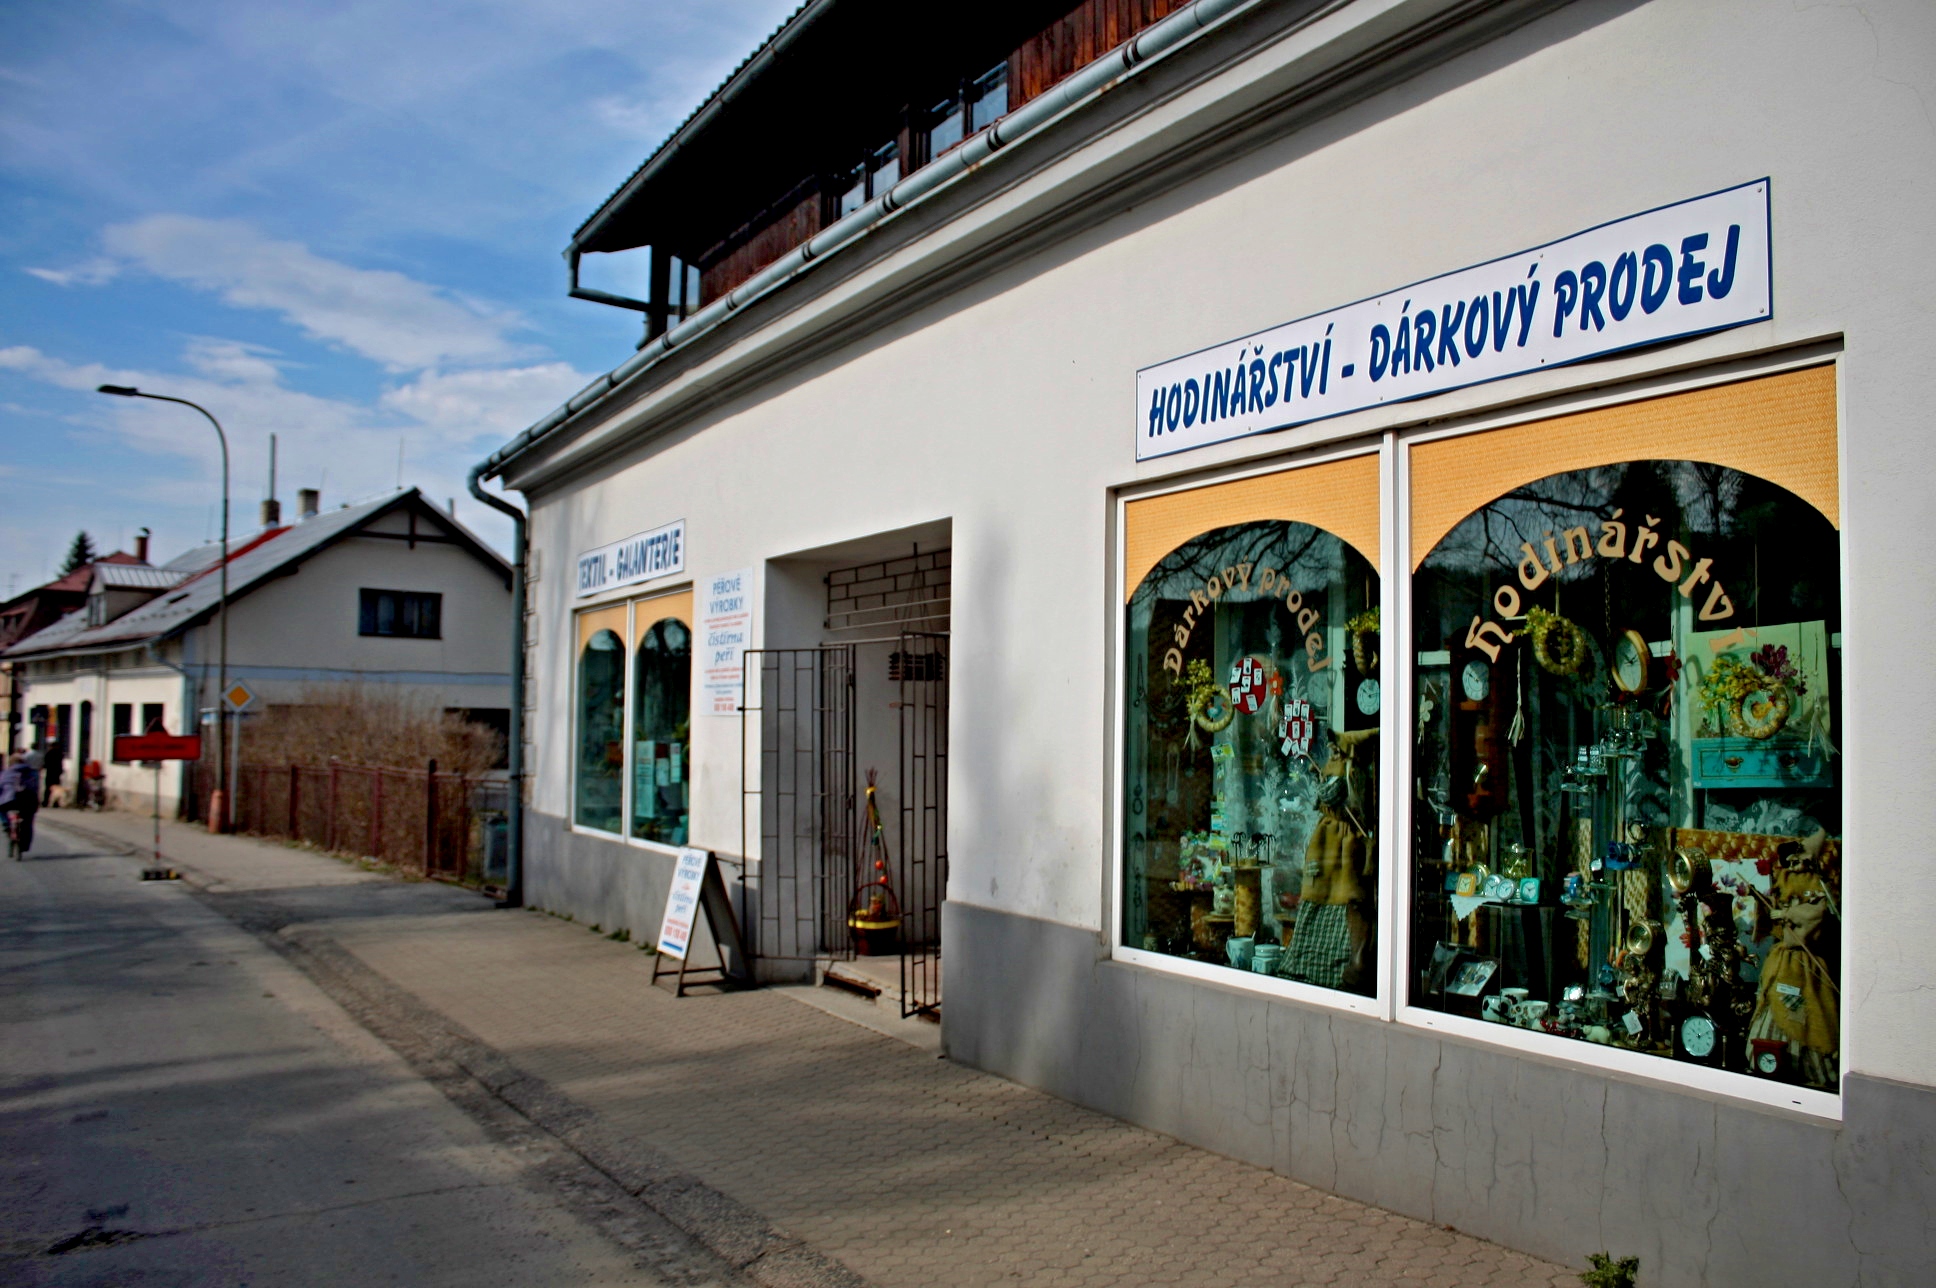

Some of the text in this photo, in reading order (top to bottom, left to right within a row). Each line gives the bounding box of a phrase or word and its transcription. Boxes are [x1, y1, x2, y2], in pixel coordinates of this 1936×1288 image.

[1149, 323, 1334, 438] HODINÁŘSTVÍ
[1368, 264, 1541, 384] DÁRKOVÝ
[1553, 224, 1740, 338] PRODEJ
[578, 553, 606, 591] TEXTIL
[616, 528, 681, 581] GALANTERIE
[1163, 555, 1332, 677] Dárkový prodej
